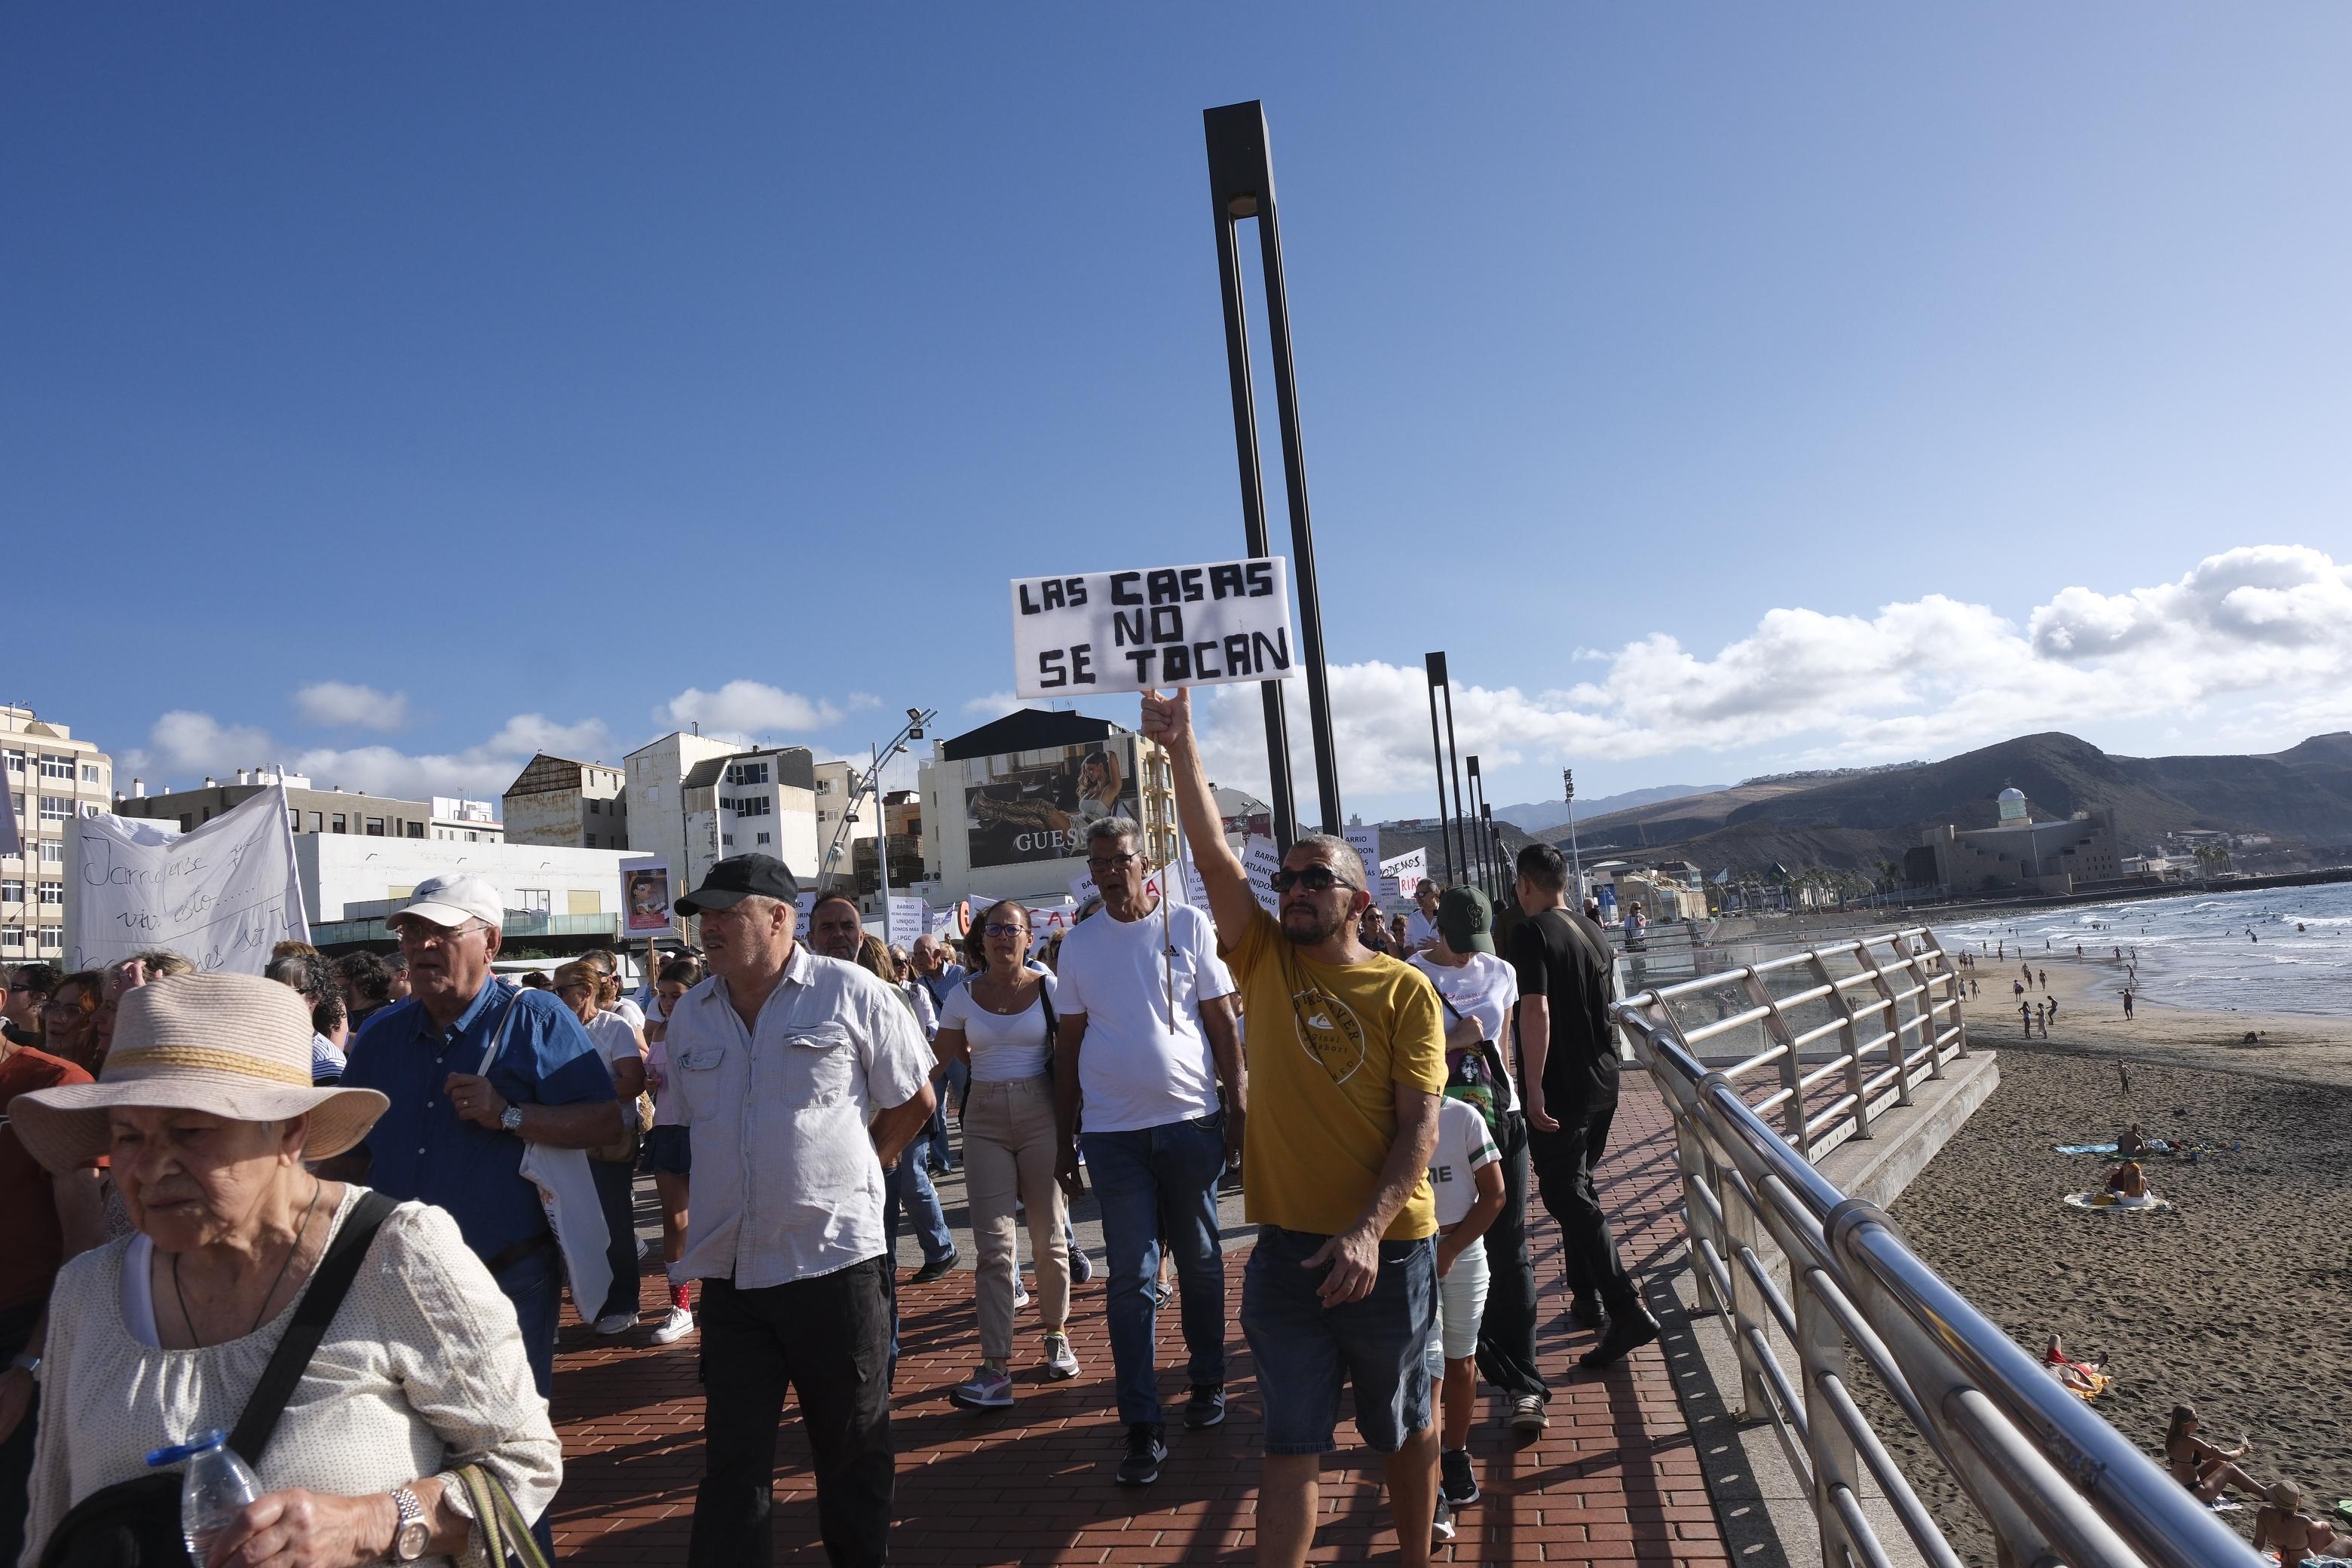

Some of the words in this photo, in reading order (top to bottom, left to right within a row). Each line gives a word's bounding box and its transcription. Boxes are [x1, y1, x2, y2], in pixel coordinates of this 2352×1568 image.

[1020, 577, 1087, 615] LAS
[1110, 562, 1272, 606] CASAS
[1114, 605, 1183, 646] NO
[1040, 644, 1096, 688] SE
[1125, 627, 1290, 683] TOCAN
[1244, 861, 1276, 877] ATLÁNTI
[1260, 893, 1276, 906] MÁS
